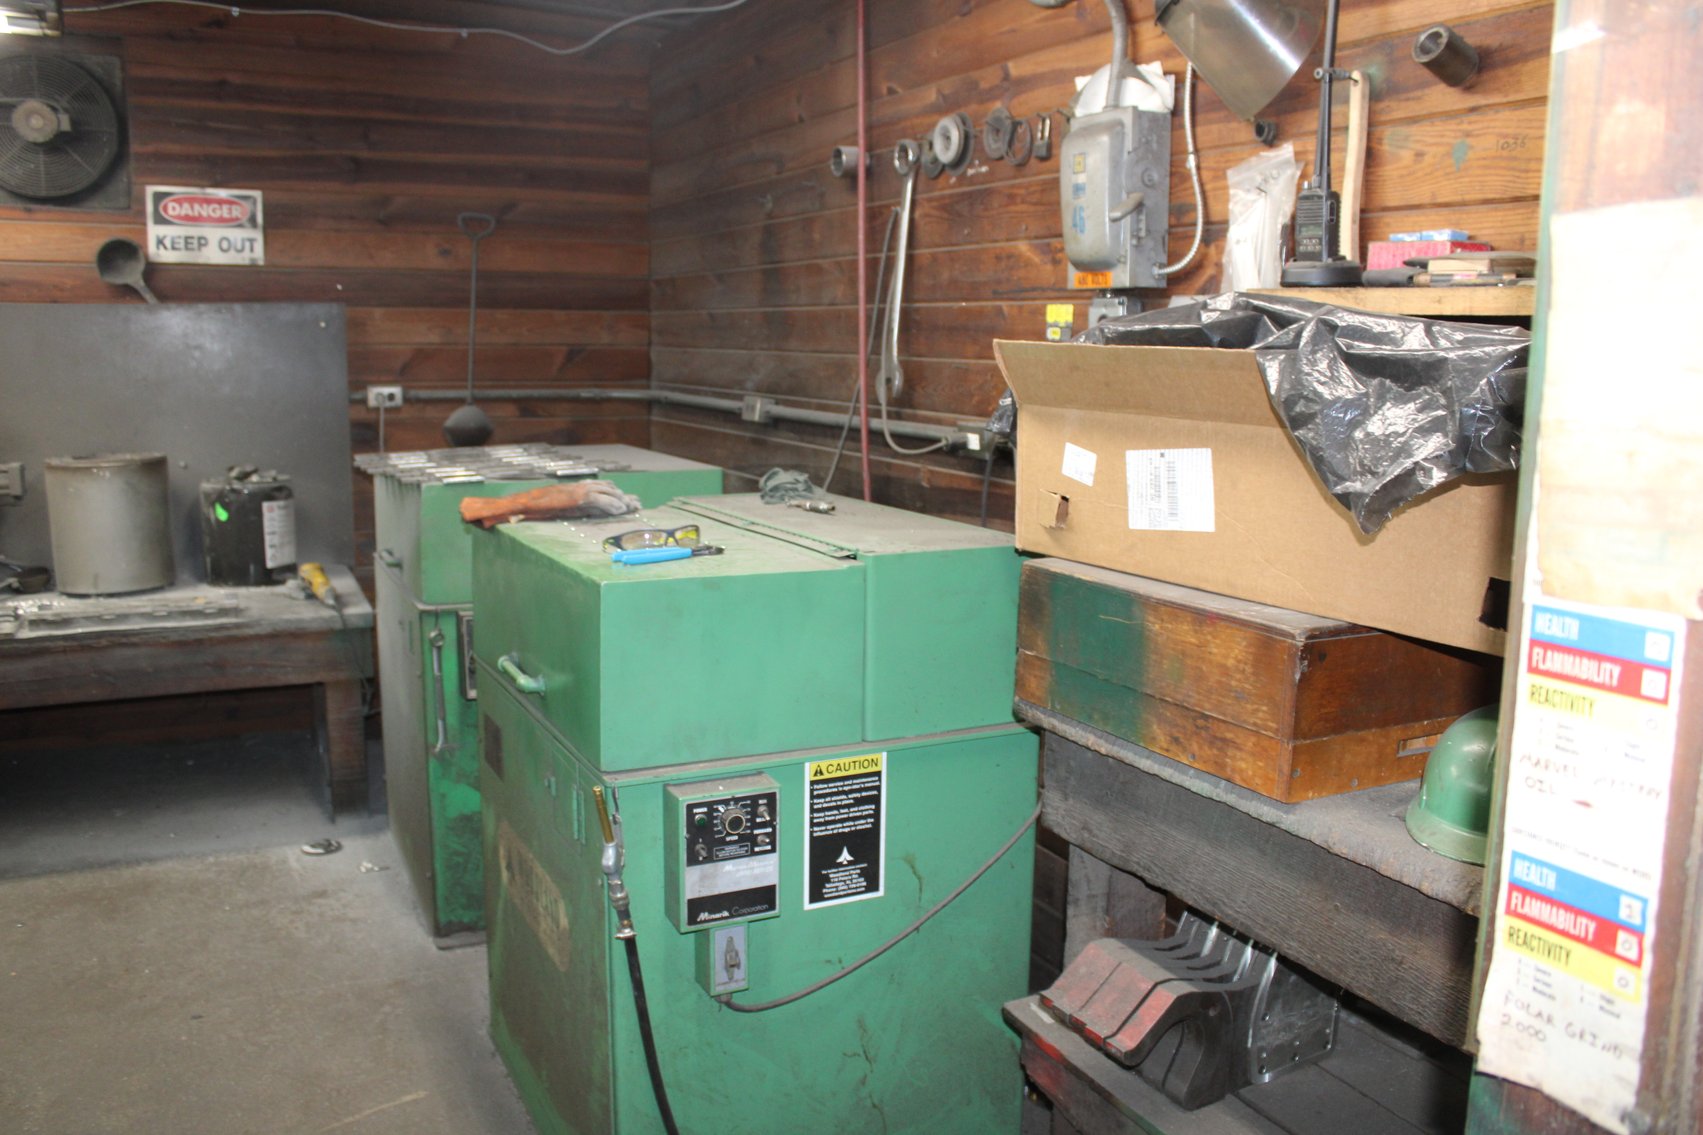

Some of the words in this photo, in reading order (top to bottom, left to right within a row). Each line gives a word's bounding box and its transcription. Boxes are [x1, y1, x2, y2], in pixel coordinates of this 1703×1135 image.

[166, 201, 242, 219] DANGER
[155, 234, 209, 251] KEEP
[217, 236, 257, 254] OUT
[1534, 611, 1580, 641] HEALTH
[1532, 646, 1621, 687] FLAMMABILITY
[1529, 683, 1595, 717] REACTIVITY
[825, 757, 879, 775] CAUTION
[1512, 857, 1557, 892] HEALTH
[1510, 891, 1596, 941] FLAMMABILITY
[1508, 925, 1572, 967] REACTIVITY
